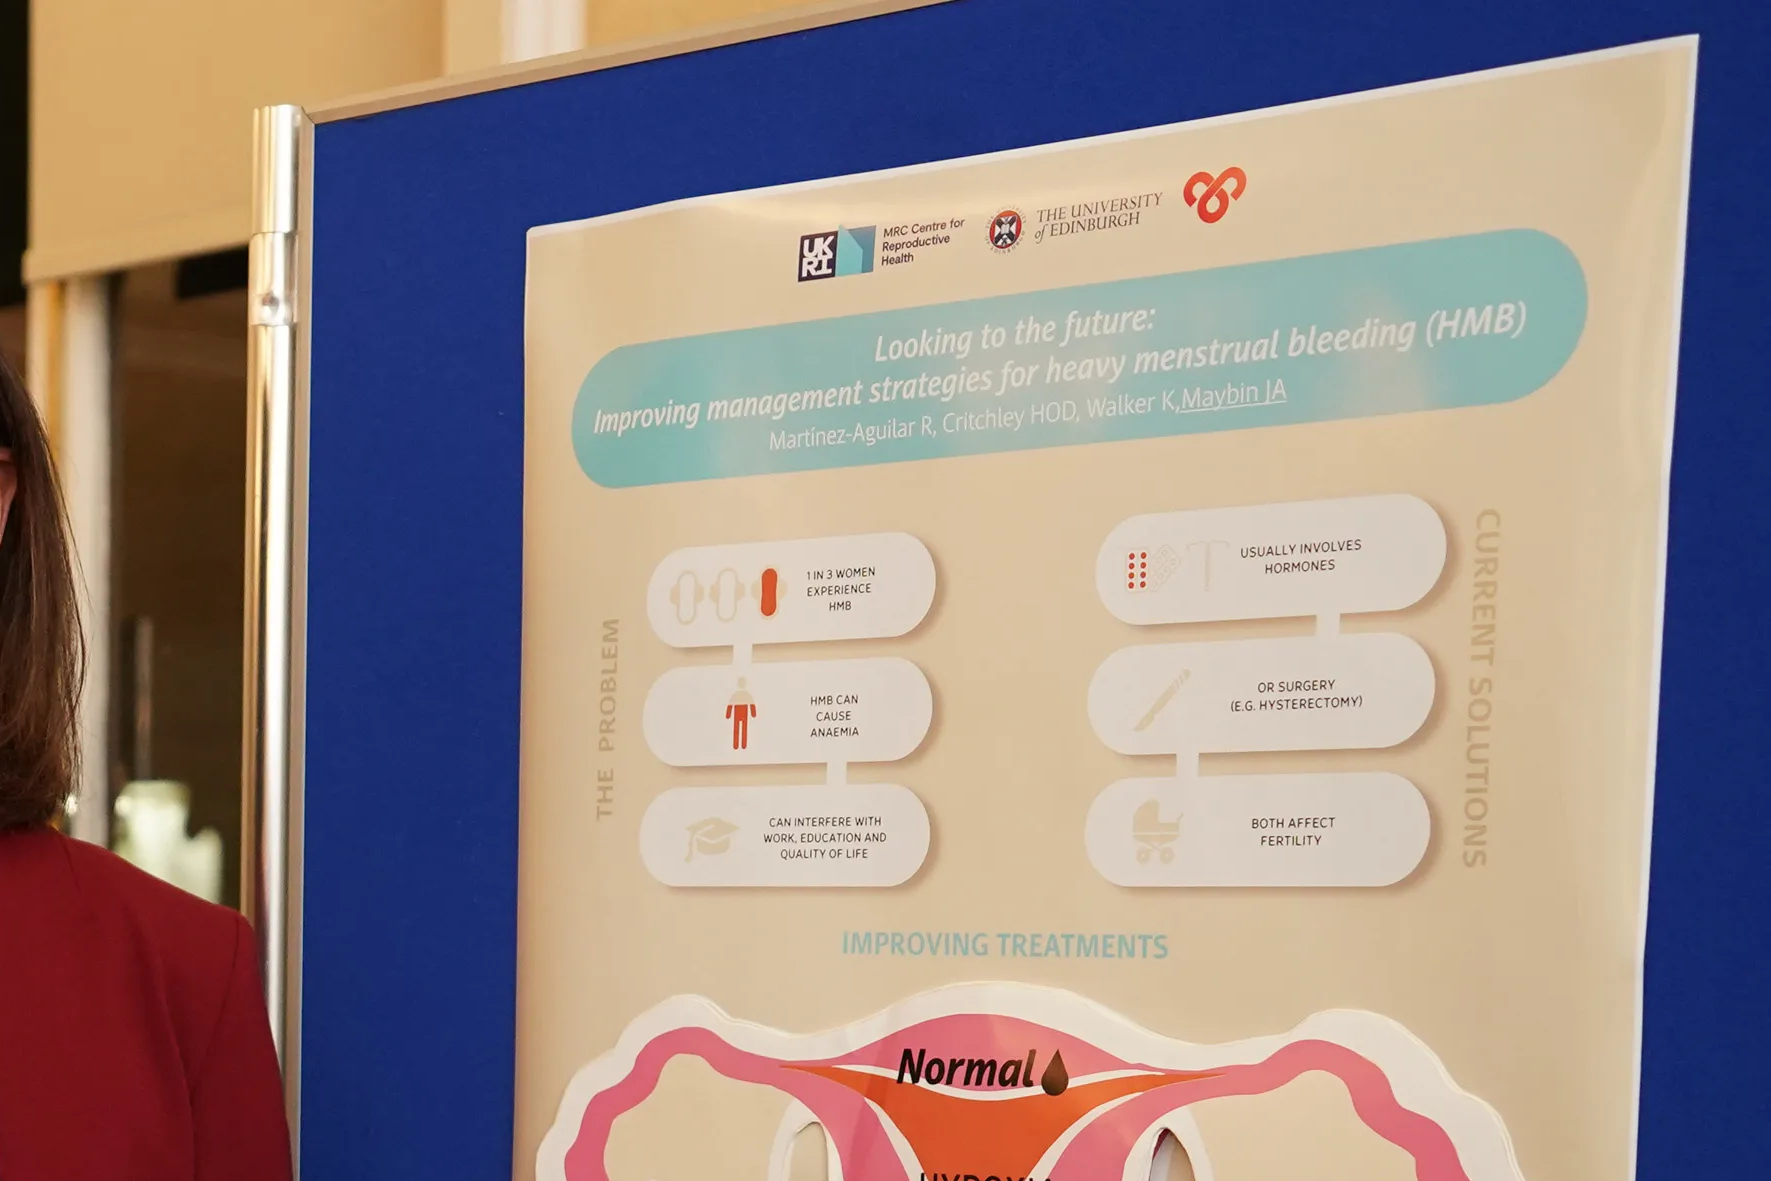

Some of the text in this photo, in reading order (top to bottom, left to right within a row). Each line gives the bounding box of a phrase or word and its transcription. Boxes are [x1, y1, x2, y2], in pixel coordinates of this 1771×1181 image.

[1036, 192, 1162, 222] THE UNIVERSITY
[883, 218, 965, 238] MRC Centre for
[1034, 225, 1045, 244] of
[1050, 211, 1139, 236] EDINBURGH
[882, 235, 950, 252] Reproductive
[881, 252, 914, 266] Health
[875, 308, 1156, 362] Looking to the future:
[593, 301, 1526, 436] Improving management strategies for heavy menstrual bleeding (HMB)
[770, 418, 916, 450] Martínez-Aguilar
[942, 406, 1025, 433] Critchley
[1086, 393, 1156, 418] Walker
[1162, 382, 1260, 413] K,Maybin
[1263, 378, 1286, 405] JA
[1240, 538, 1361, 558] USUALLY INVOLVES
[807, 567, 875, 580] 1 IN 3 WOMEN
[1265, 558, 1335, 574] HORMONES
[807, 582, 871, 597] EXPERIENCE
[829, 600, 851, 611] HMB
[1257, 679, 1335, 693] OR SURGERY
[1462, 508, 1502, 868] CURRENT SOLUTIONS
[810, 694, 858, 705] HMB CAN
[1230, 695, 1362, 712] (E.G. HYSTERECTOMY)
[596, 618, 620, 822] THE PROBLEM
[816, 710, 851, 722] CAUSE
[810, 726, 859, 737] ANAEMIA
[768, 816, 881, 827] CAN INTERFERE WITH
[1251, 816, 1335, 829] BOTH AFFECT
[763, 832, 886, 843] WORK, EDUCATION AND
[1260, 835, 1322, 846] FERTILITY
[780, 848, 868, 860] QUALITY OF LIFE
[842, 931, 1169, 959] IMPROVING TREATMENTS
[896, 1048, 1036, 1088] Normal
